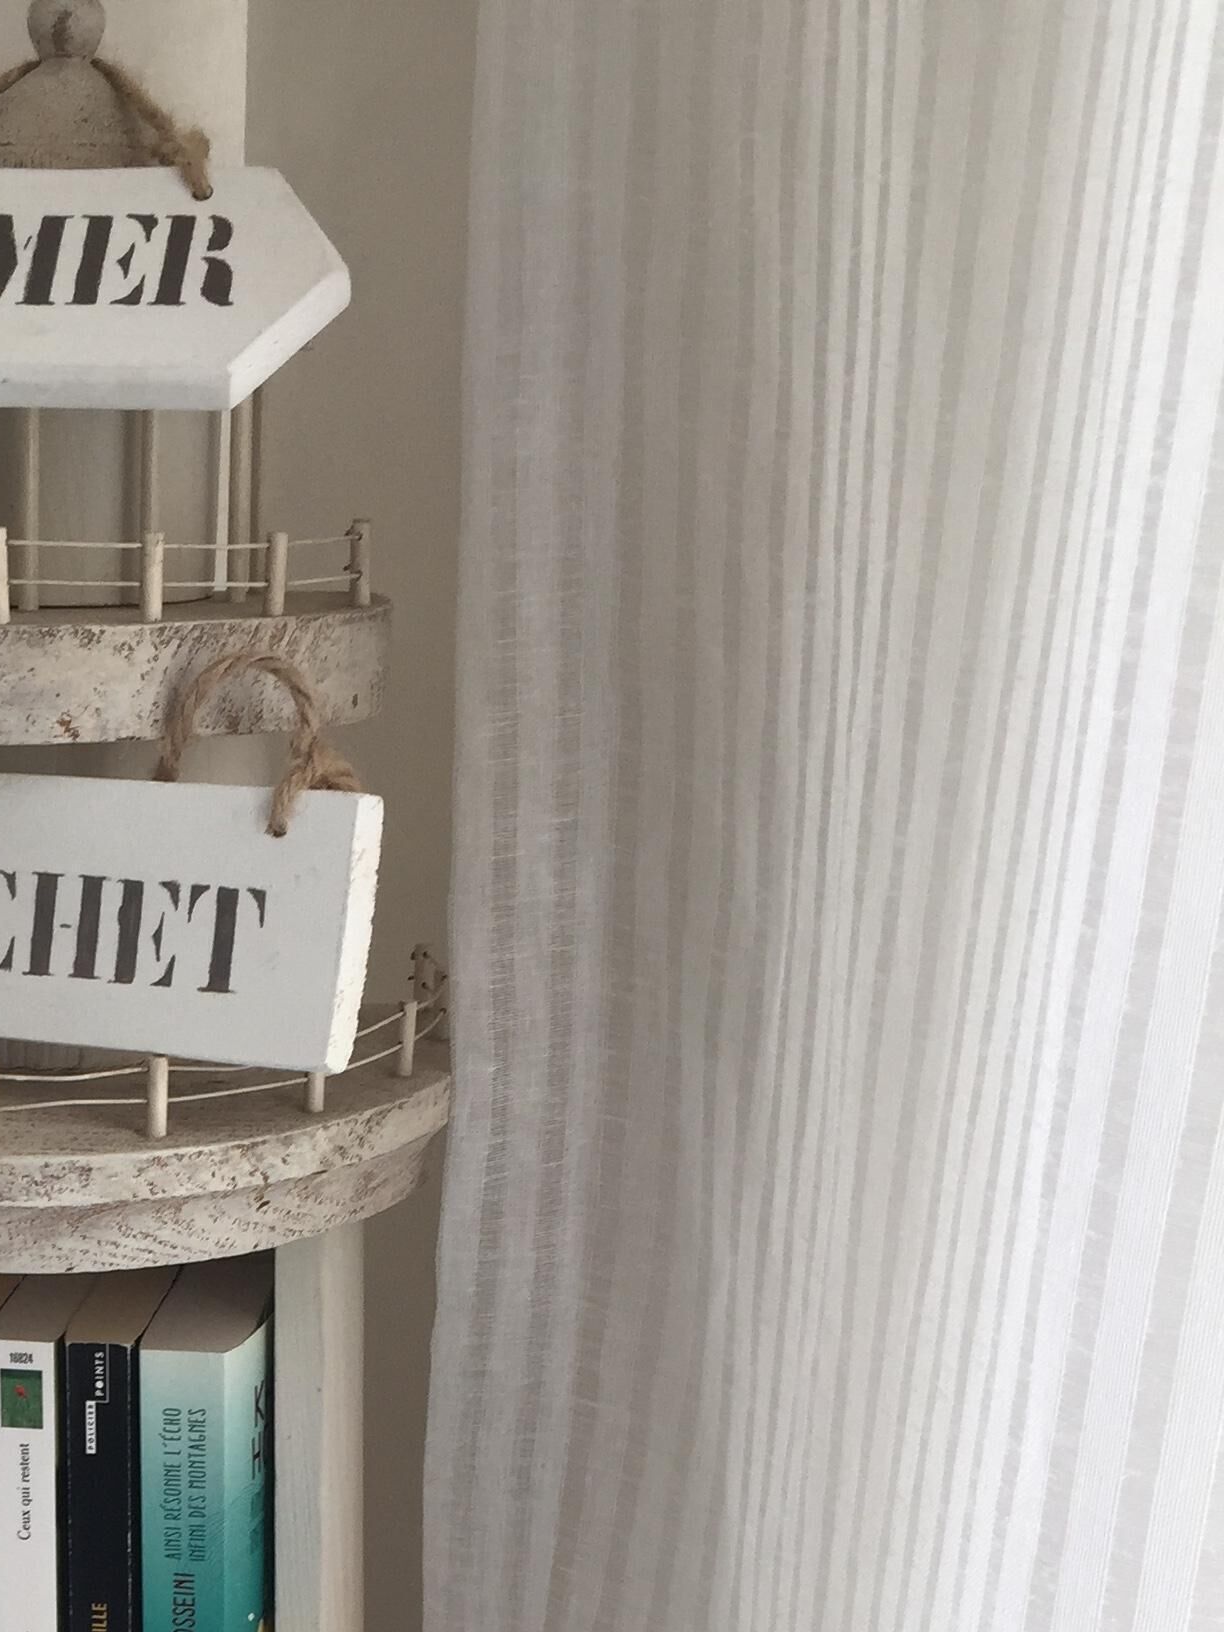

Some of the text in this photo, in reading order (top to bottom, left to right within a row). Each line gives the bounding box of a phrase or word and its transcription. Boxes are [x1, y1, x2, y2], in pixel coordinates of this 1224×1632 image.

[94, 1351, 105, 1397] POINTS
[87, 1404, 95, 1451] POLICIER
[16, 1443, 33, 1541] Ceux qui restent
[159, 1406, 182, 1560] AINSI RÉSONNE L'ÉCHO
[187, 1408, 207, 1562] INFINI DES MONTAGNES
